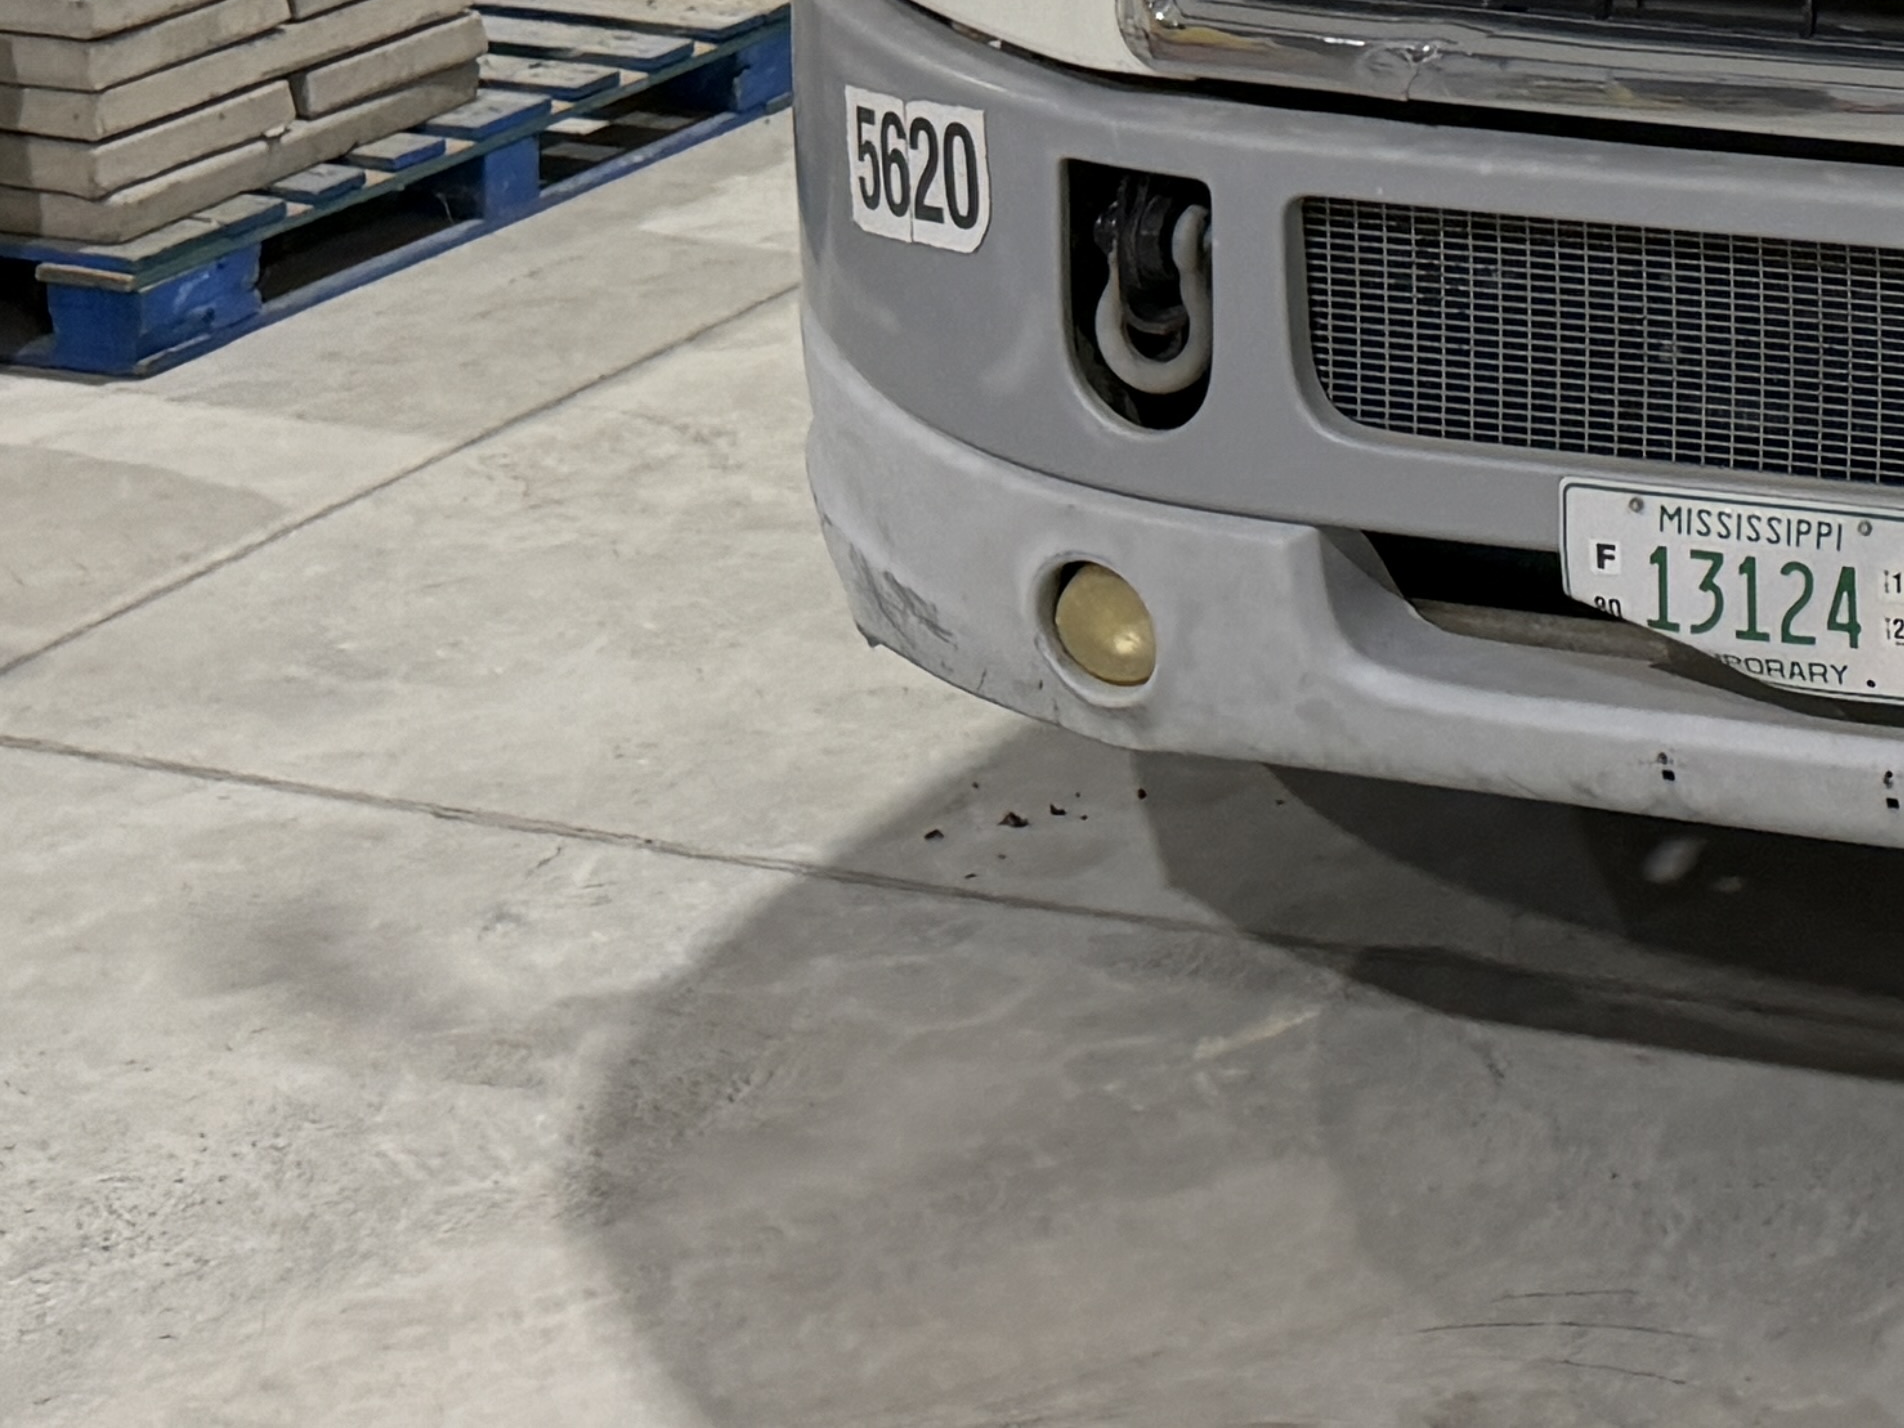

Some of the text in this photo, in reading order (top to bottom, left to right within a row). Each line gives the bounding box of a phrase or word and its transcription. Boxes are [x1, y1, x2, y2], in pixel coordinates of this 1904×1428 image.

[856, 105, 979, 229] 5620
[1660, 505, 1843, 551] MISSISSIPPI
[1596, 543, 1616, 570] F
[1647, 545, 1862, 649] 13124
[1715, 653, 1848, 685] PORARY
